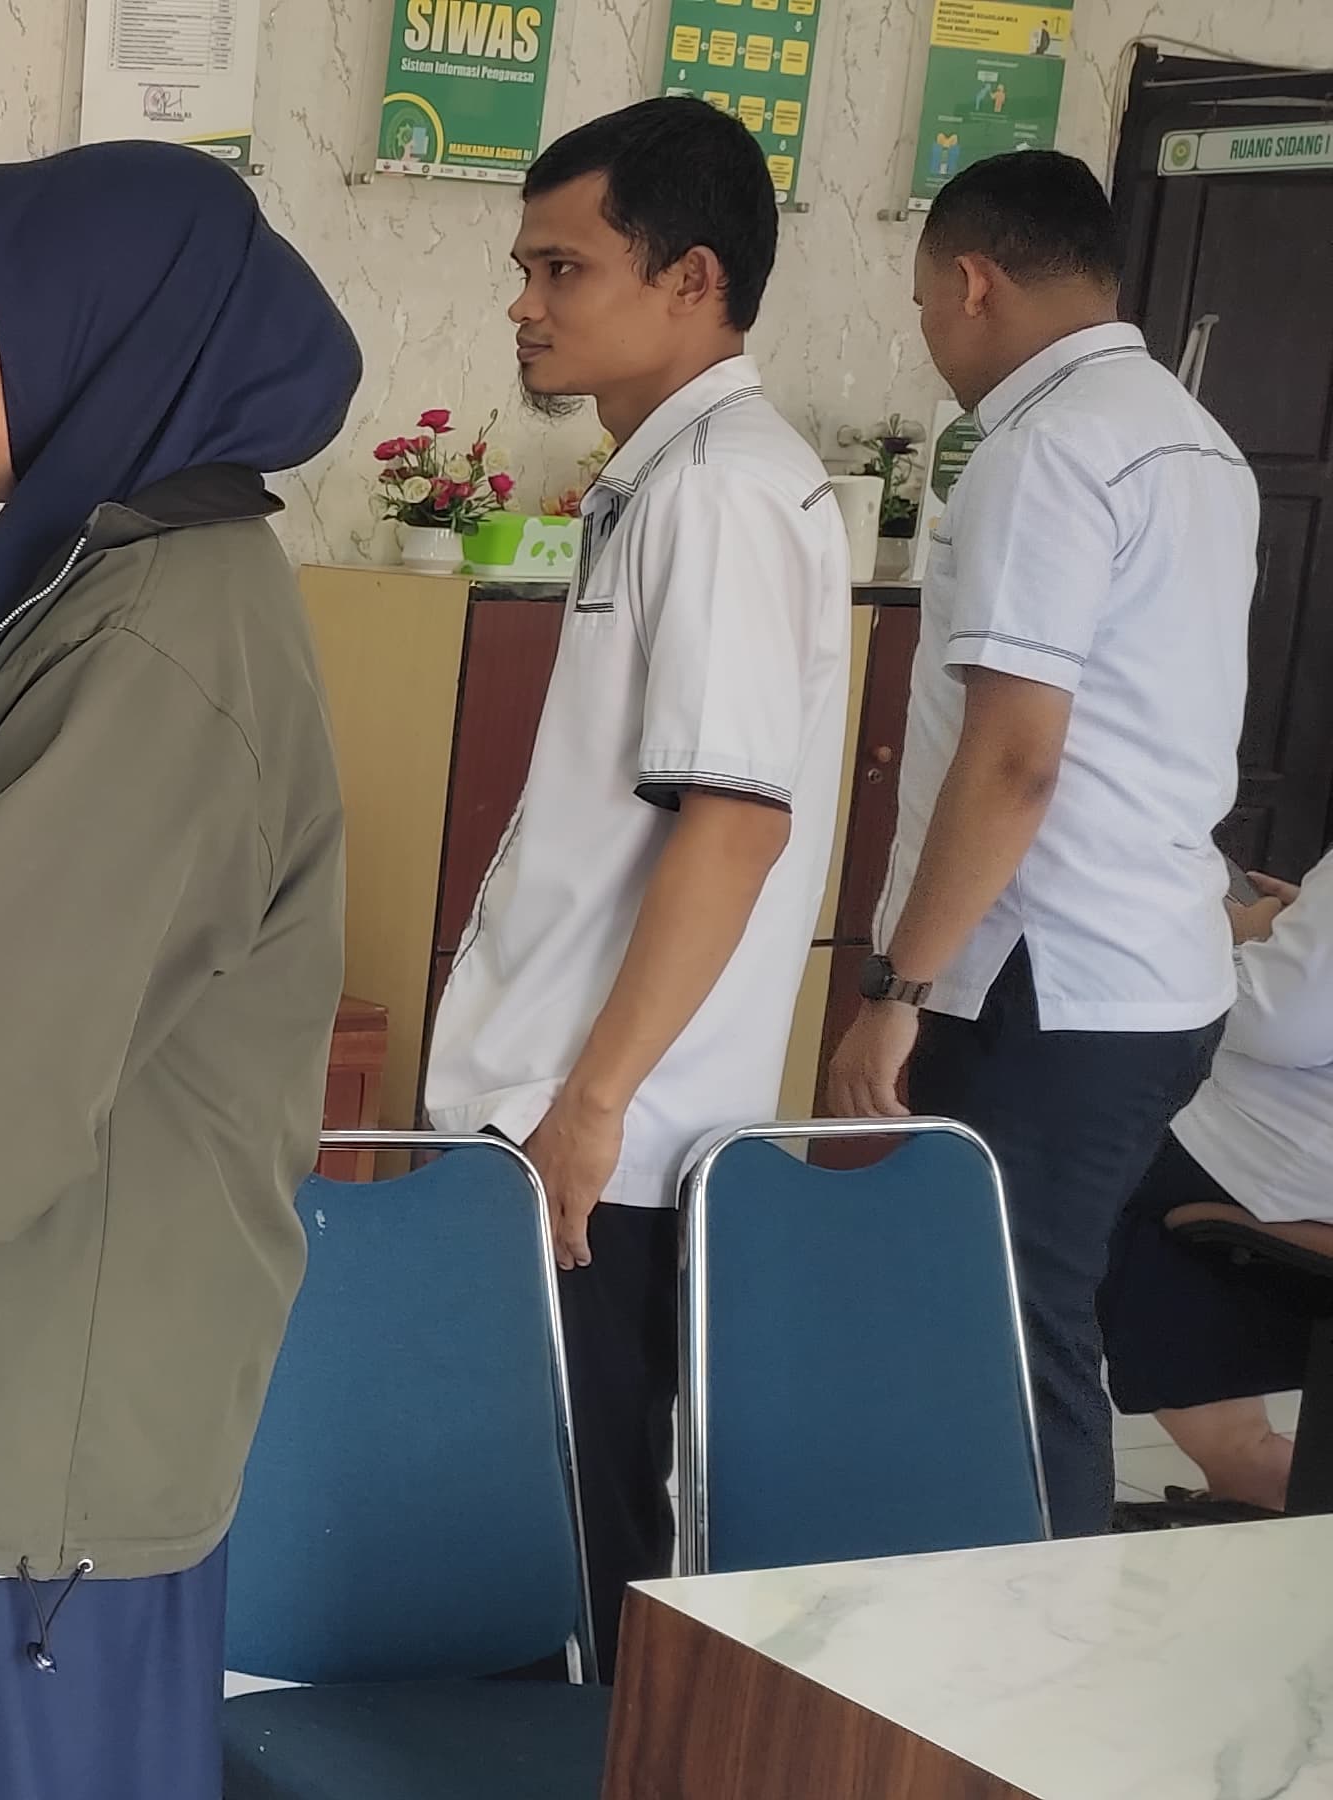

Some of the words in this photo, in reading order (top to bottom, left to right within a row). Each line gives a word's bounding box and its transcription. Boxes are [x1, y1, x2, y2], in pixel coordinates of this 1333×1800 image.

[404, 0, 541, 62] SIWAS
[401, 57, 434, 74] Sistem
[434, 61, 480, 79] Informasi
[1229, 136, 1273, 160] RUANG
[1274, 134, 1323, 157] SIDANG
